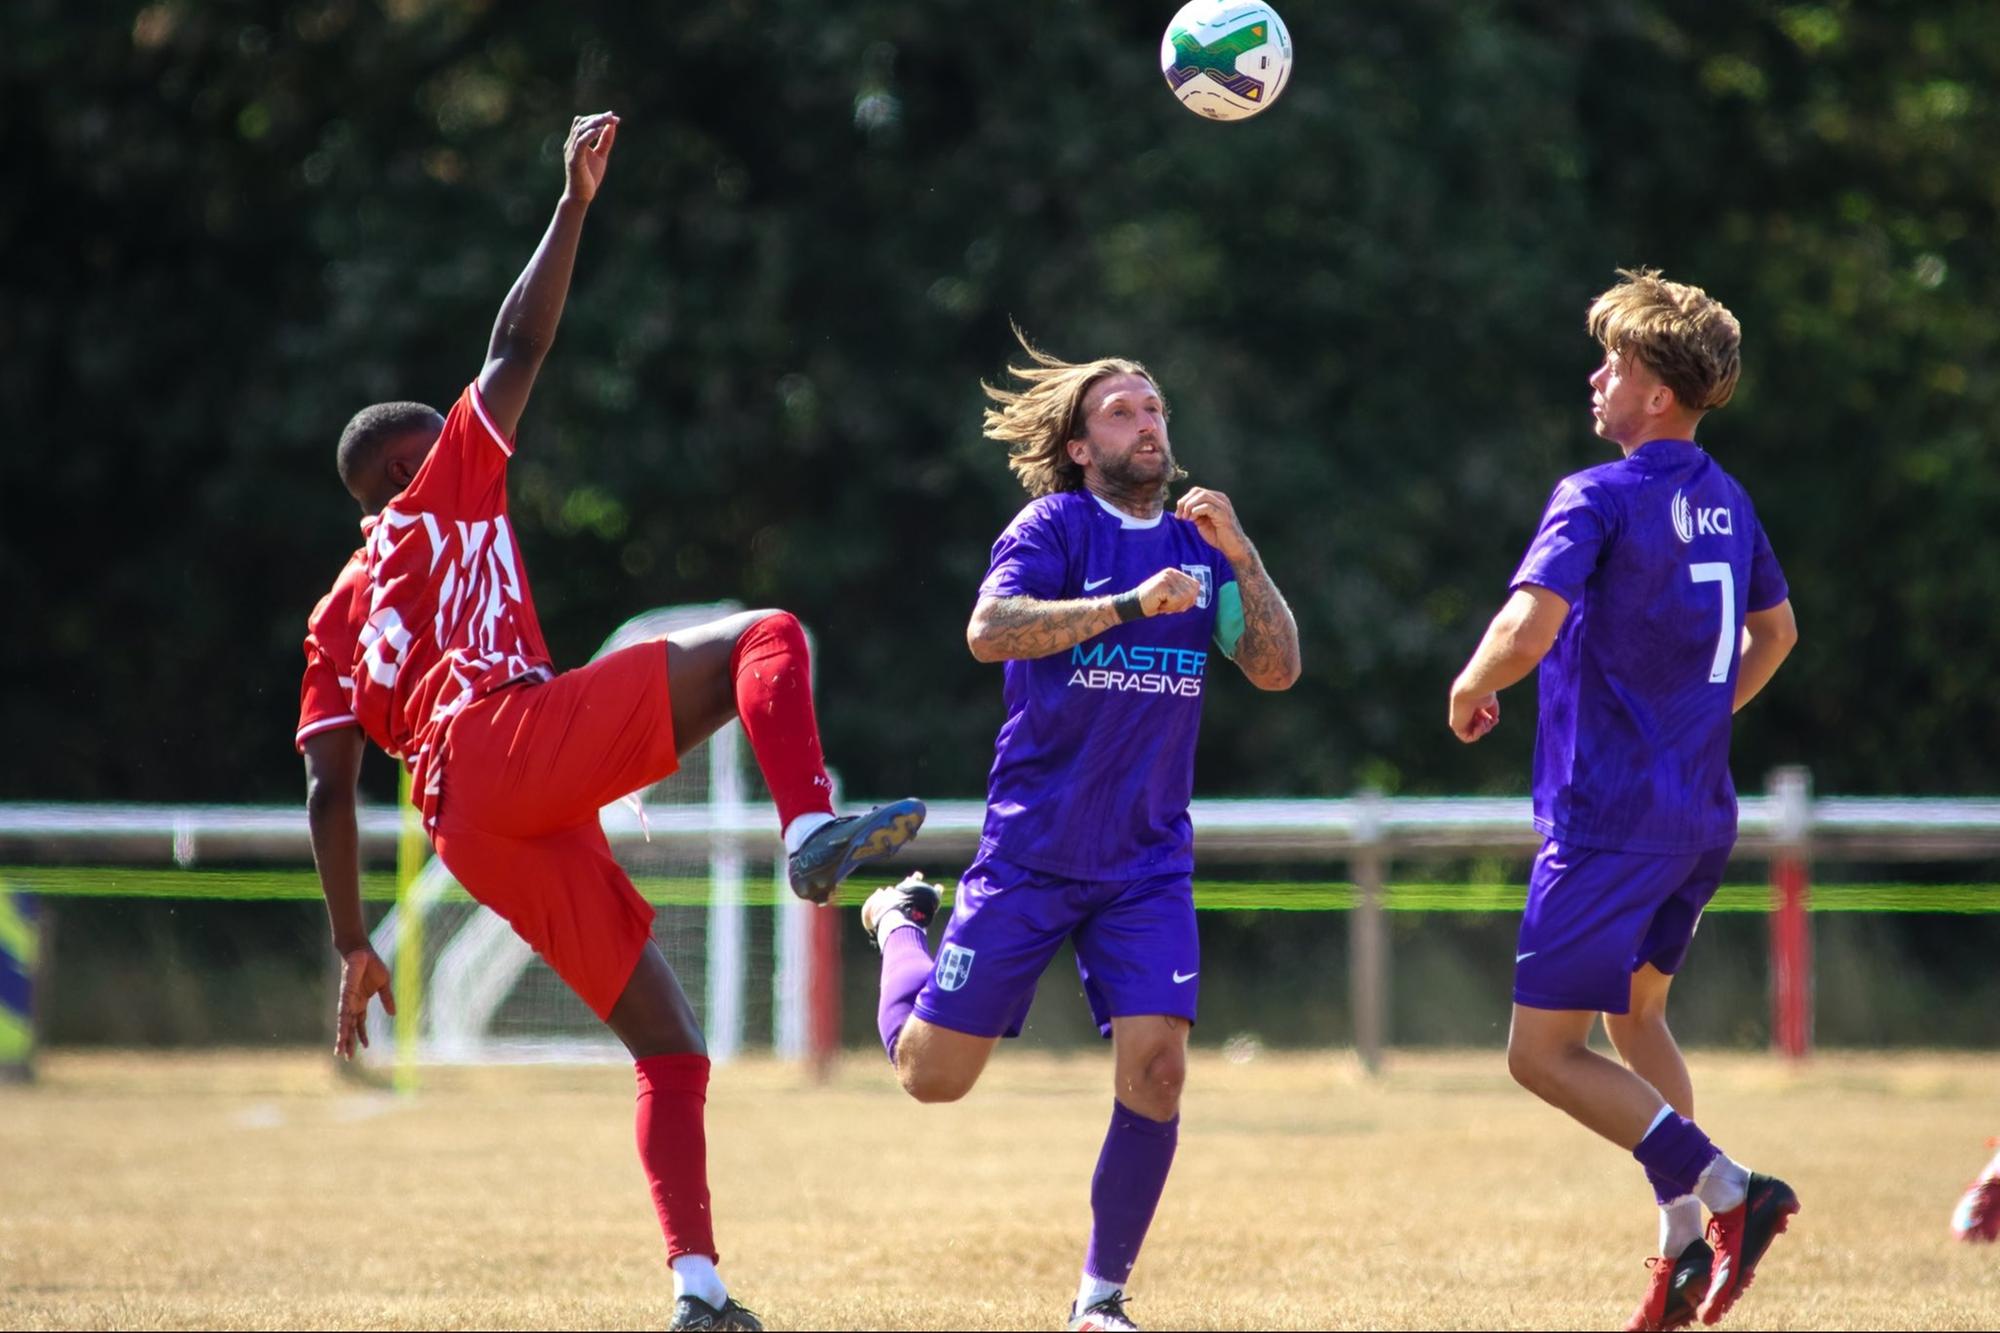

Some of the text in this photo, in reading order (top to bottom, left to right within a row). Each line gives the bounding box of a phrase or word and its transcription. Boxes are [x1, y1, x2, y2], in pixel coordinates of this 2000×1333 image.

[1689, 562, 1735, 683] 7
[1071, 642, 1208, 676] MASTER
[1067, 668, 1202, 698] ABRASIVES
